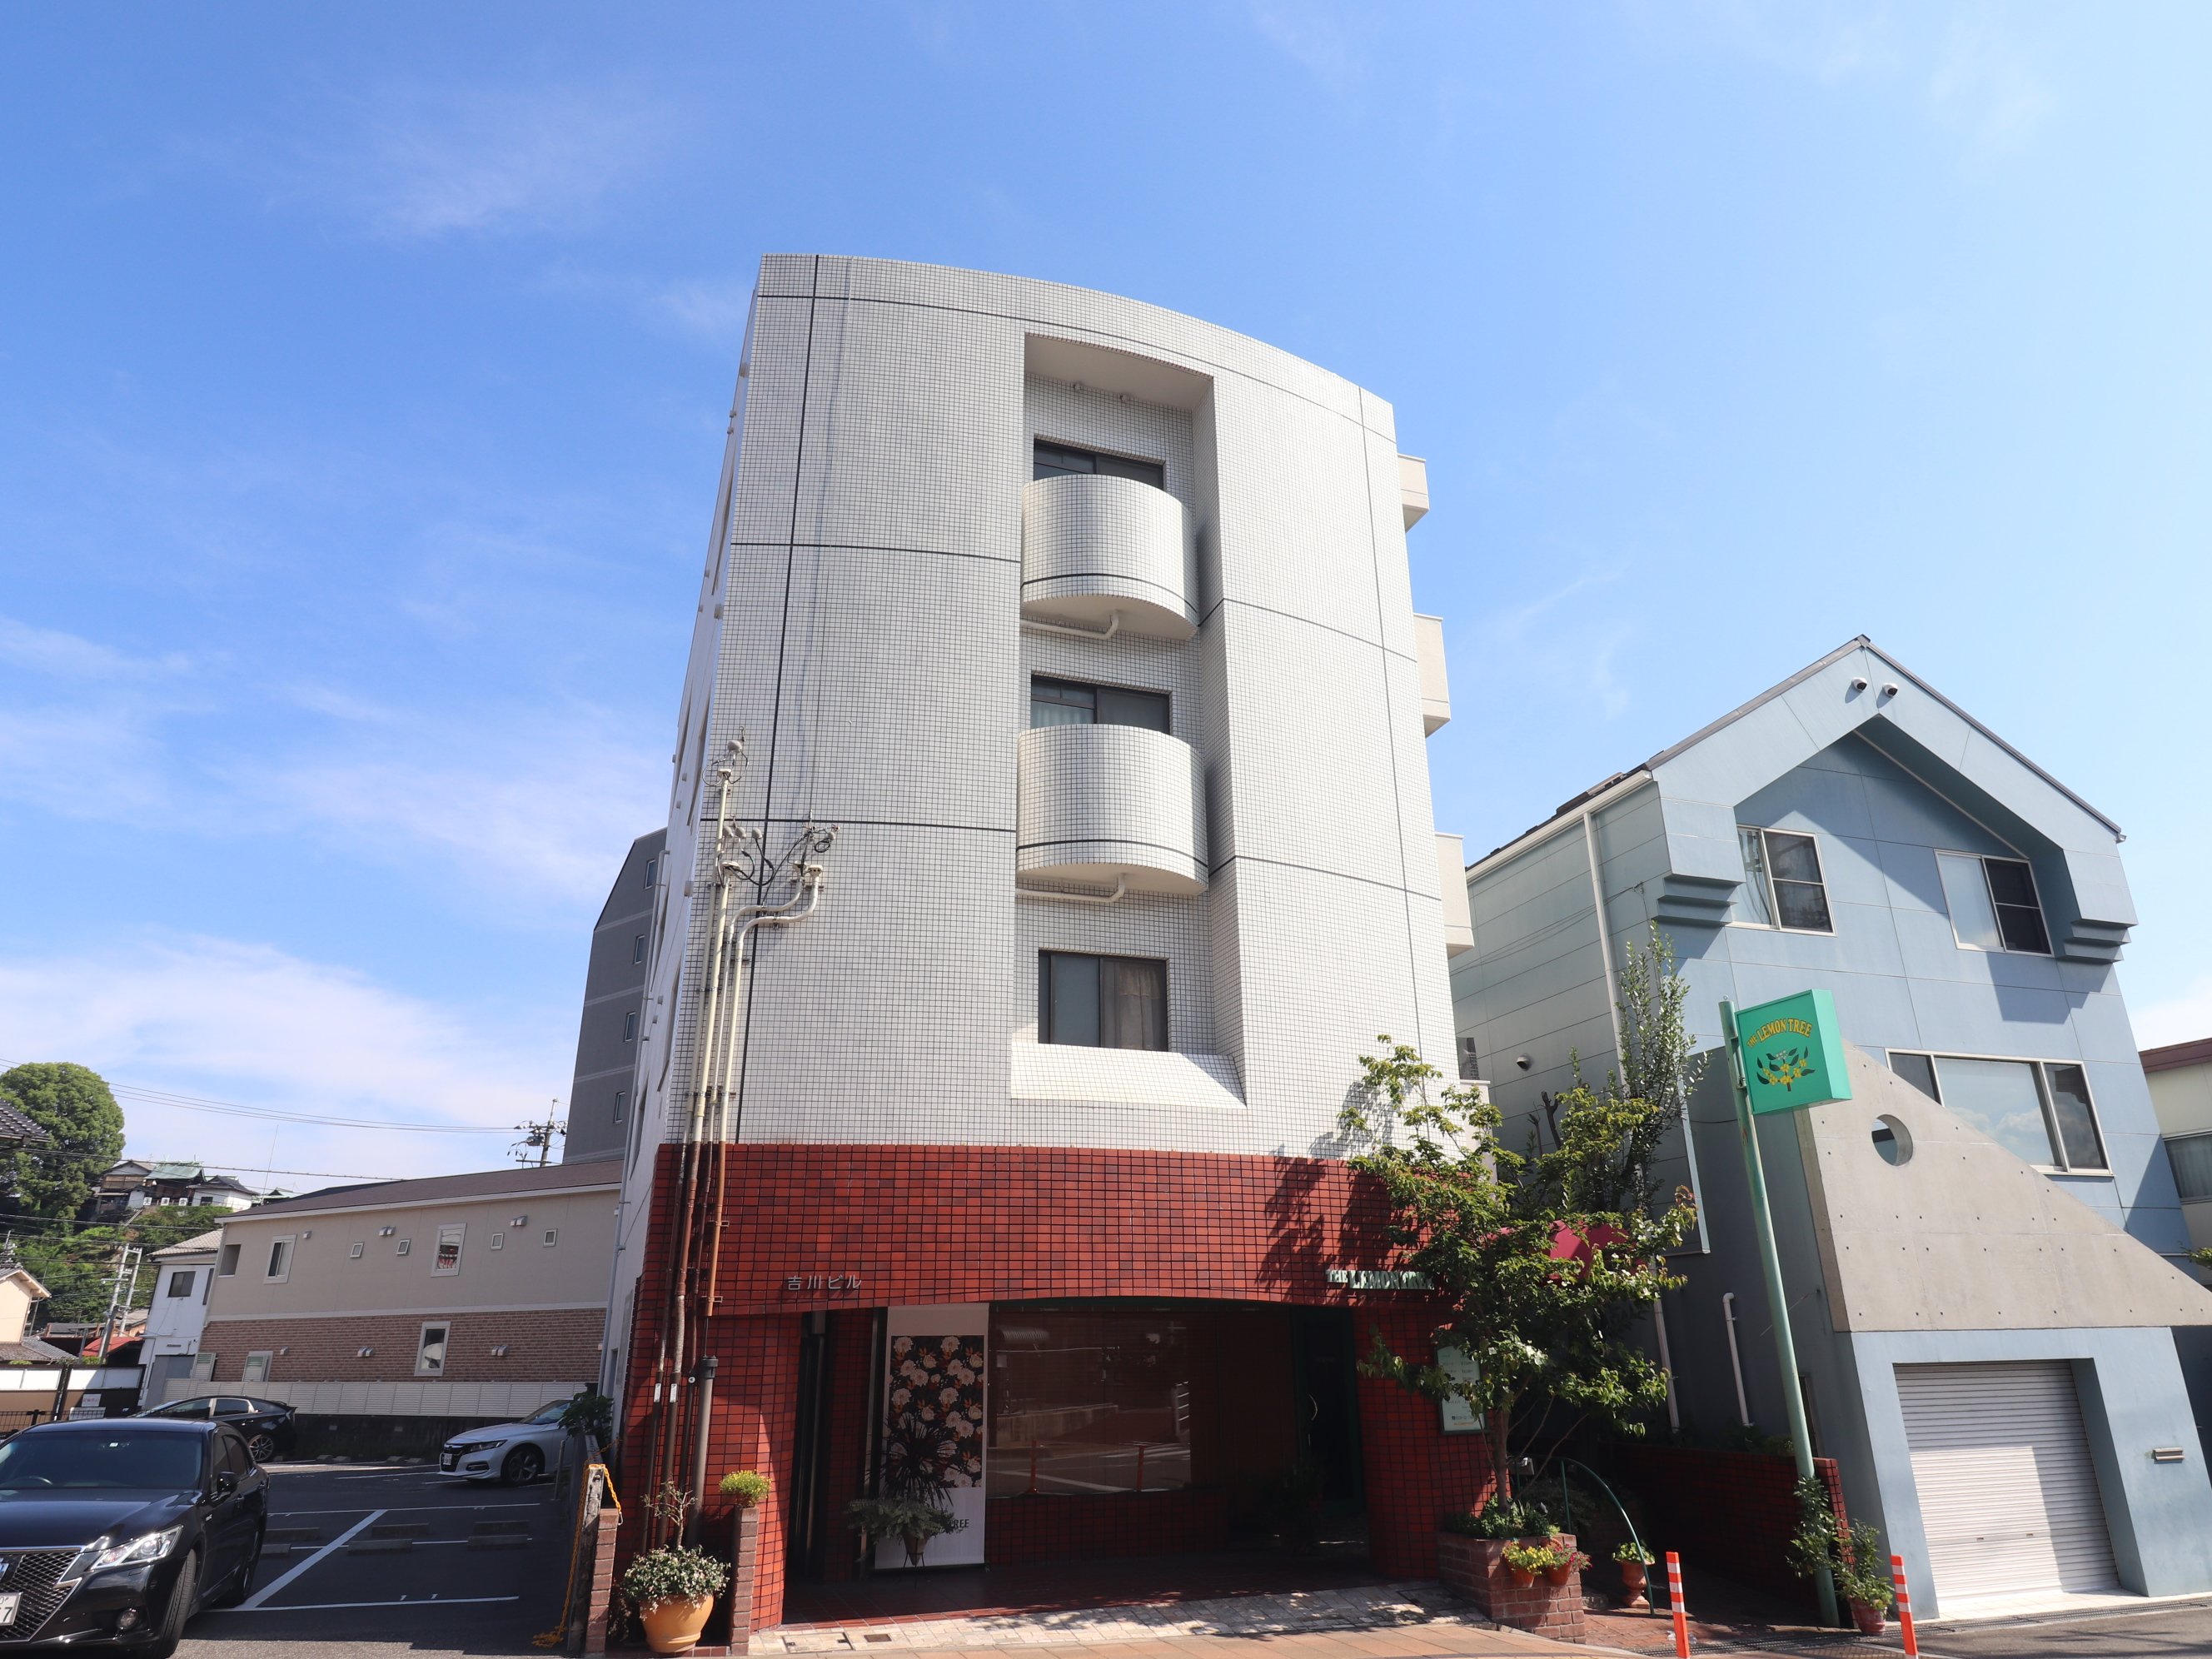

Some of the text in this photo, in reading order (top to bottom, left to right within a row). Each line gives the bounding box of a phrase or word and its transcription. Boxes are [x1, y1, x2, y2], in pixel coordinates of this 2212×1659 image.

[1746, 1018, 1813, 1048] THE LEMON TREE
[787, 1274, 862, 1290] 吉川ビル
[1326, 1269, 1348, 1283] THE
[1348, 1269, 1400, 1289] LEMON
